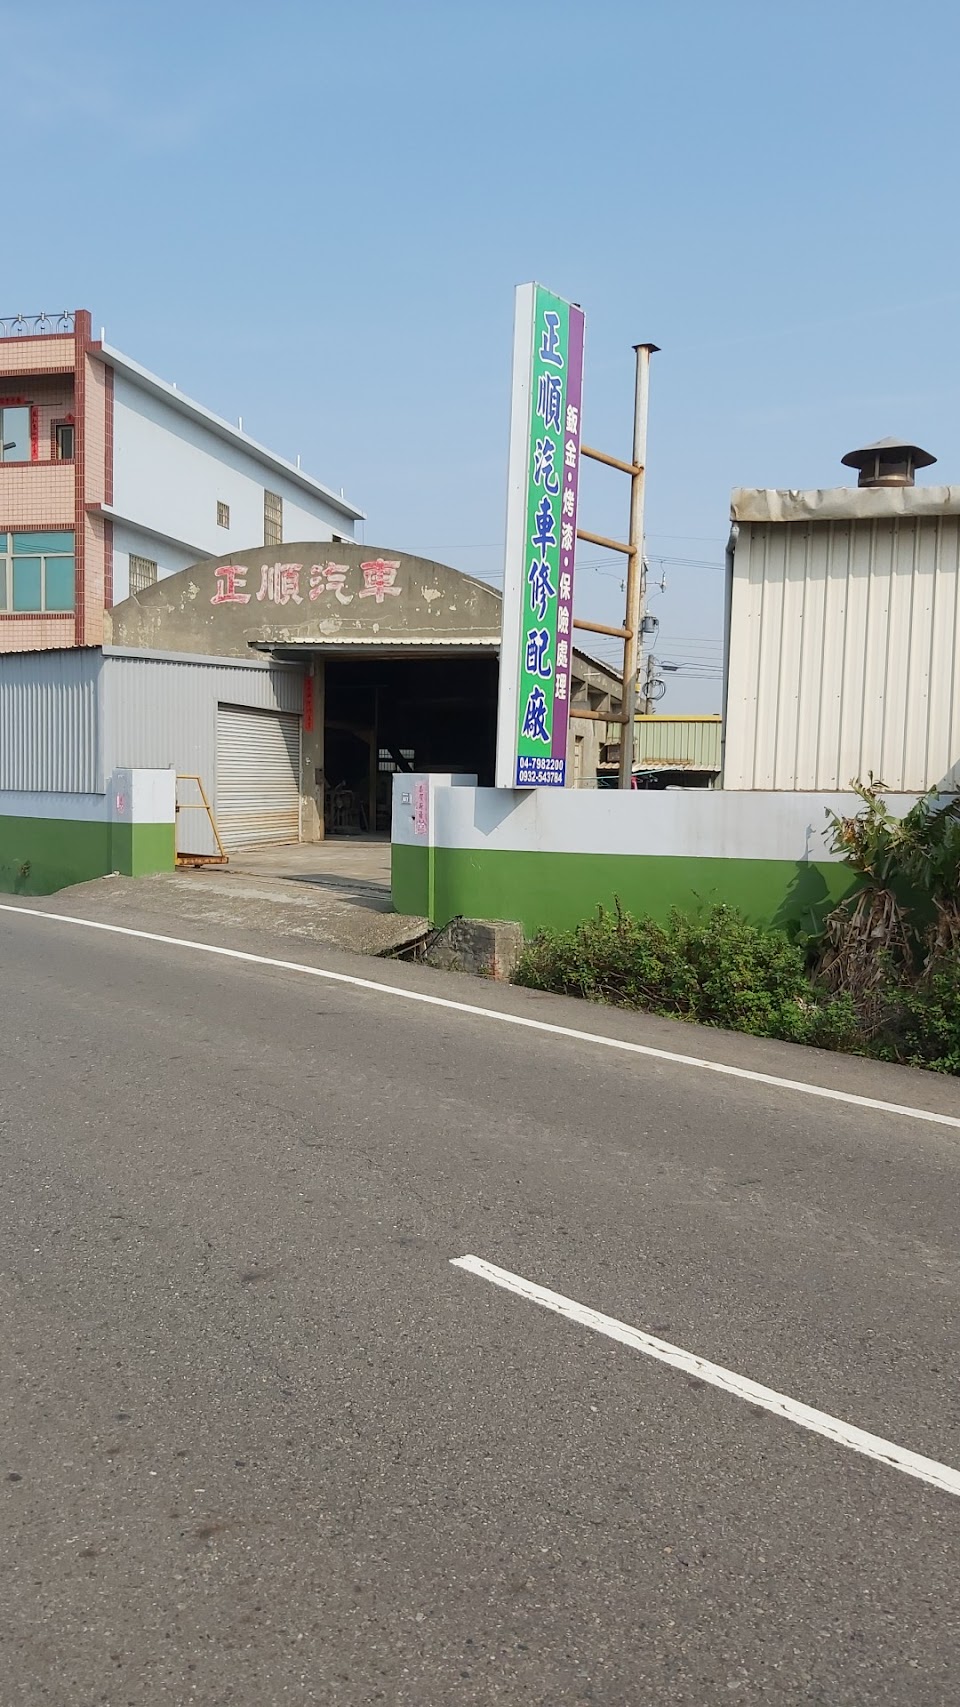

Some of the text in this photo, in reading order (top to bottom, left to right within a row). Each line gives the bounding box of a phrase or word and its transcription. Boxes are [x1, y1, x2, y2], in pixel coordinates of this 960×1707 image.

[521, 311, 563, 743] 正順汽車修配廠
[210, 558, 402, 605] 正順汽車
[519, 771, 562, 783] 0932-543784
[520, 757, 564, 770] 04-7982200
